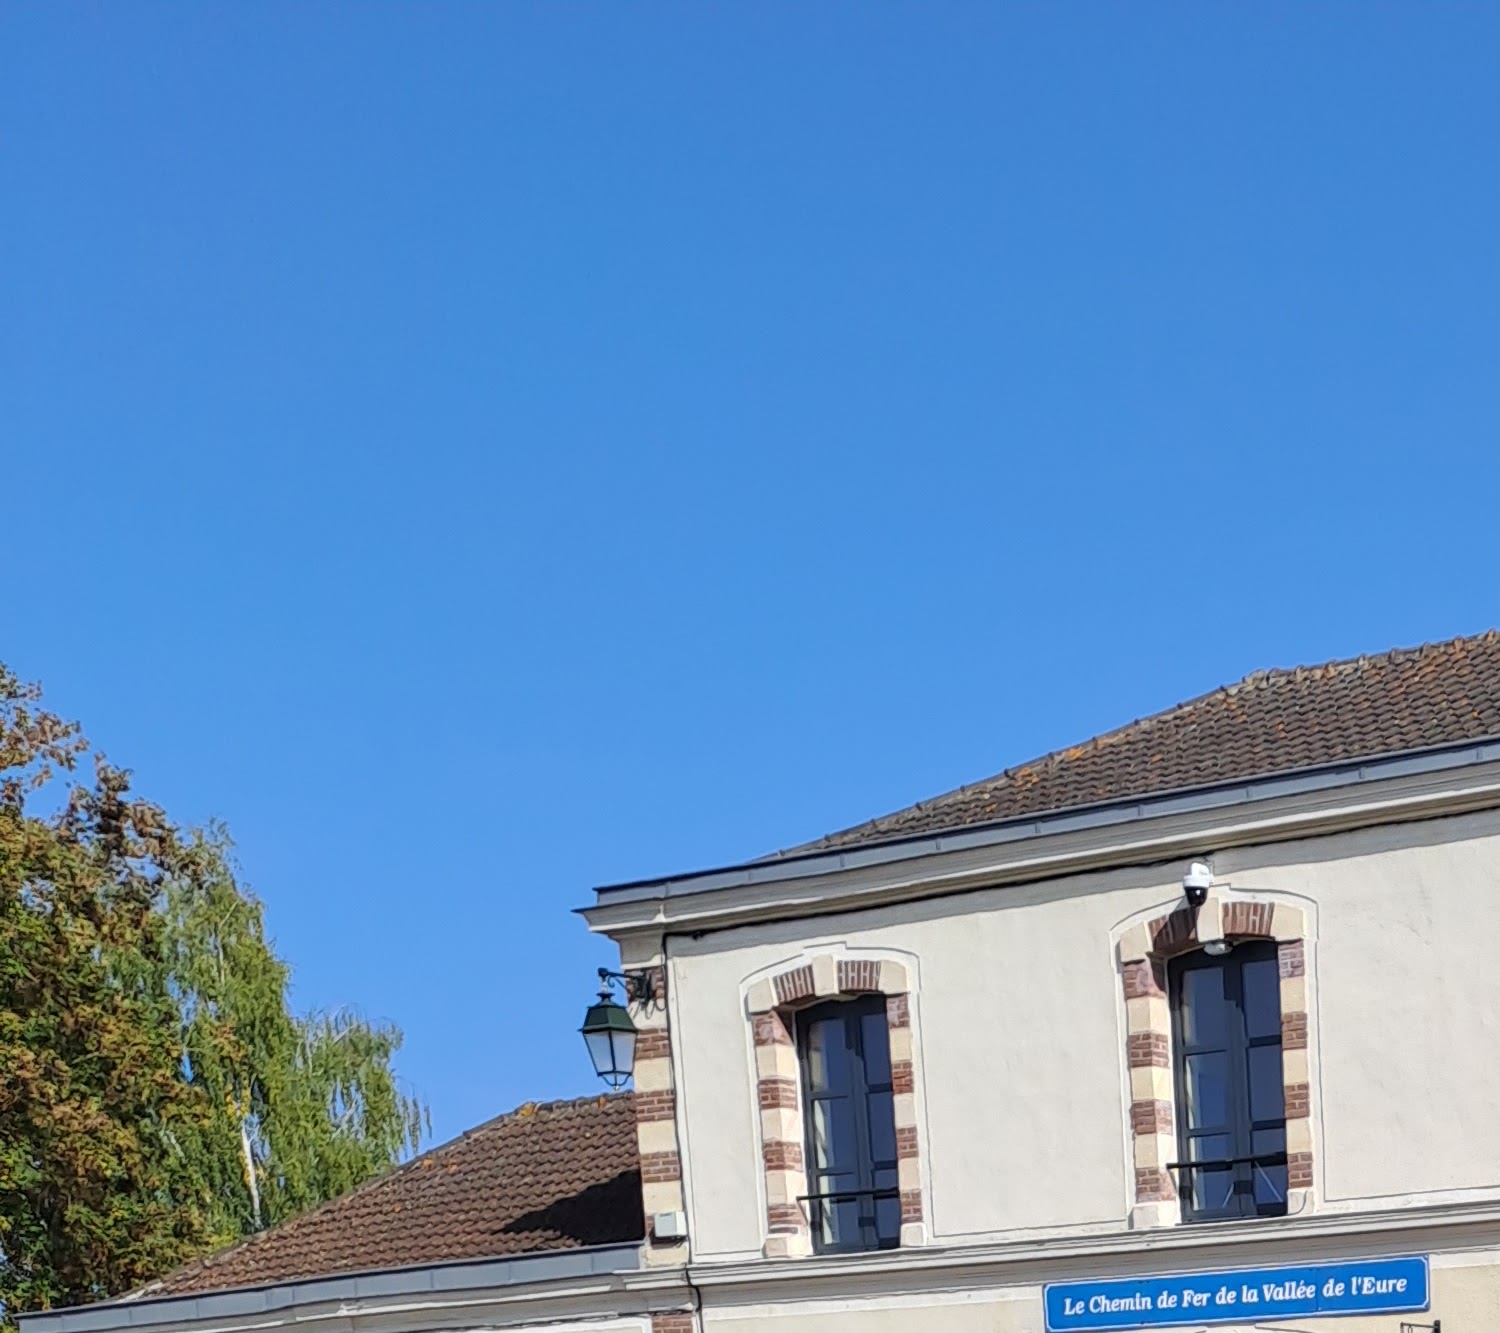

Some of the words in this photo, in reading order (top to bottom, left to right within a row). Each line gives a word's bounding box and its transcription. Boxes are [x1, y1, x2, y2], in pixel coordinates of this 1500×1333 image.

[1064, 1298, 1085, 1316] Le
[1089, 1292, 1153, 1313] Chemin
[1157, 1291, 1178, 1308] de
[1182, 1289, 1211, 1307] Fer
[1215, 1286, 1237, 1304] de
[1242, 1285, 1259, 1302] la
[1263, 1279, 1316, 1300] Vallée
[1322, 1278, 1345, 1297] de
[1350, 1276, 1408, 1295] l'Eure
